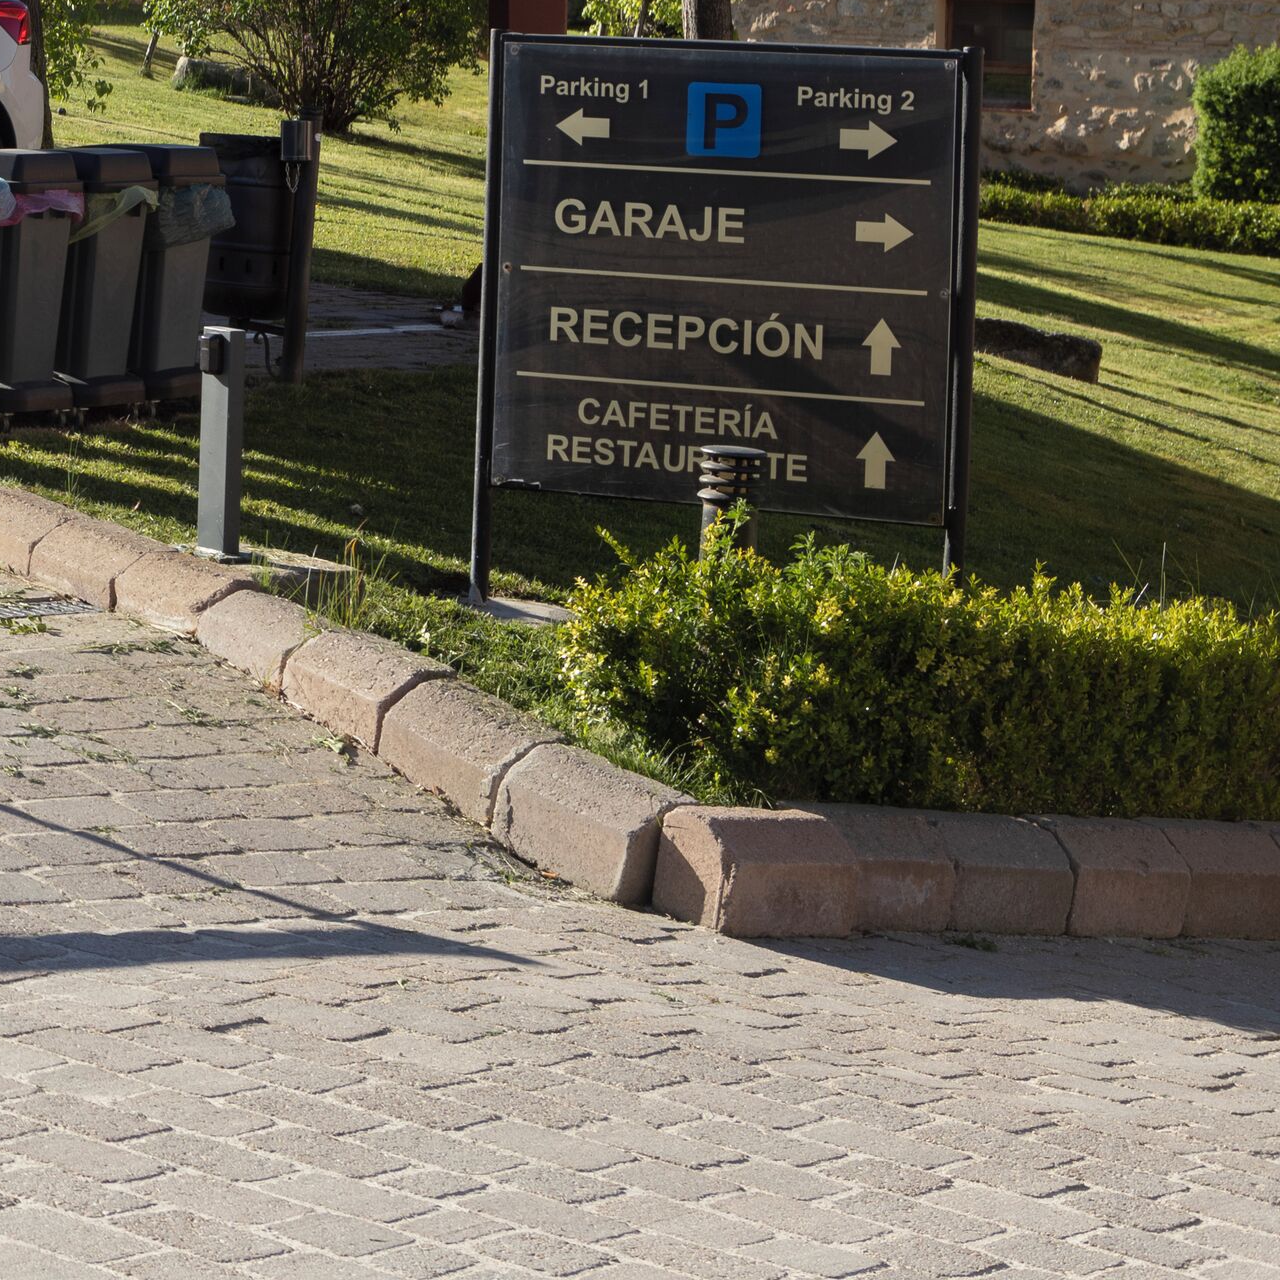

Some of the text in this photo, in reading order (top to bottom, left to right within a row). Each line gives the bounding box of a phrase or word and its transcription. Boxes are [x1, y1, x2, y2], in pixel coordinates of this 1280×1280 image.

[540, 74, 649, 102] Parking 1
[797, 86, 915, 114] Parking 2
[703, 93, 748, 150] P
[554, 198, 745, 244] GARAJE
[550, 306, 824, 361] RECEPCIÓN
[577, 397, 778, 440] CAFETERÍA
[546, 433, 808, 483] RESTAURTE
